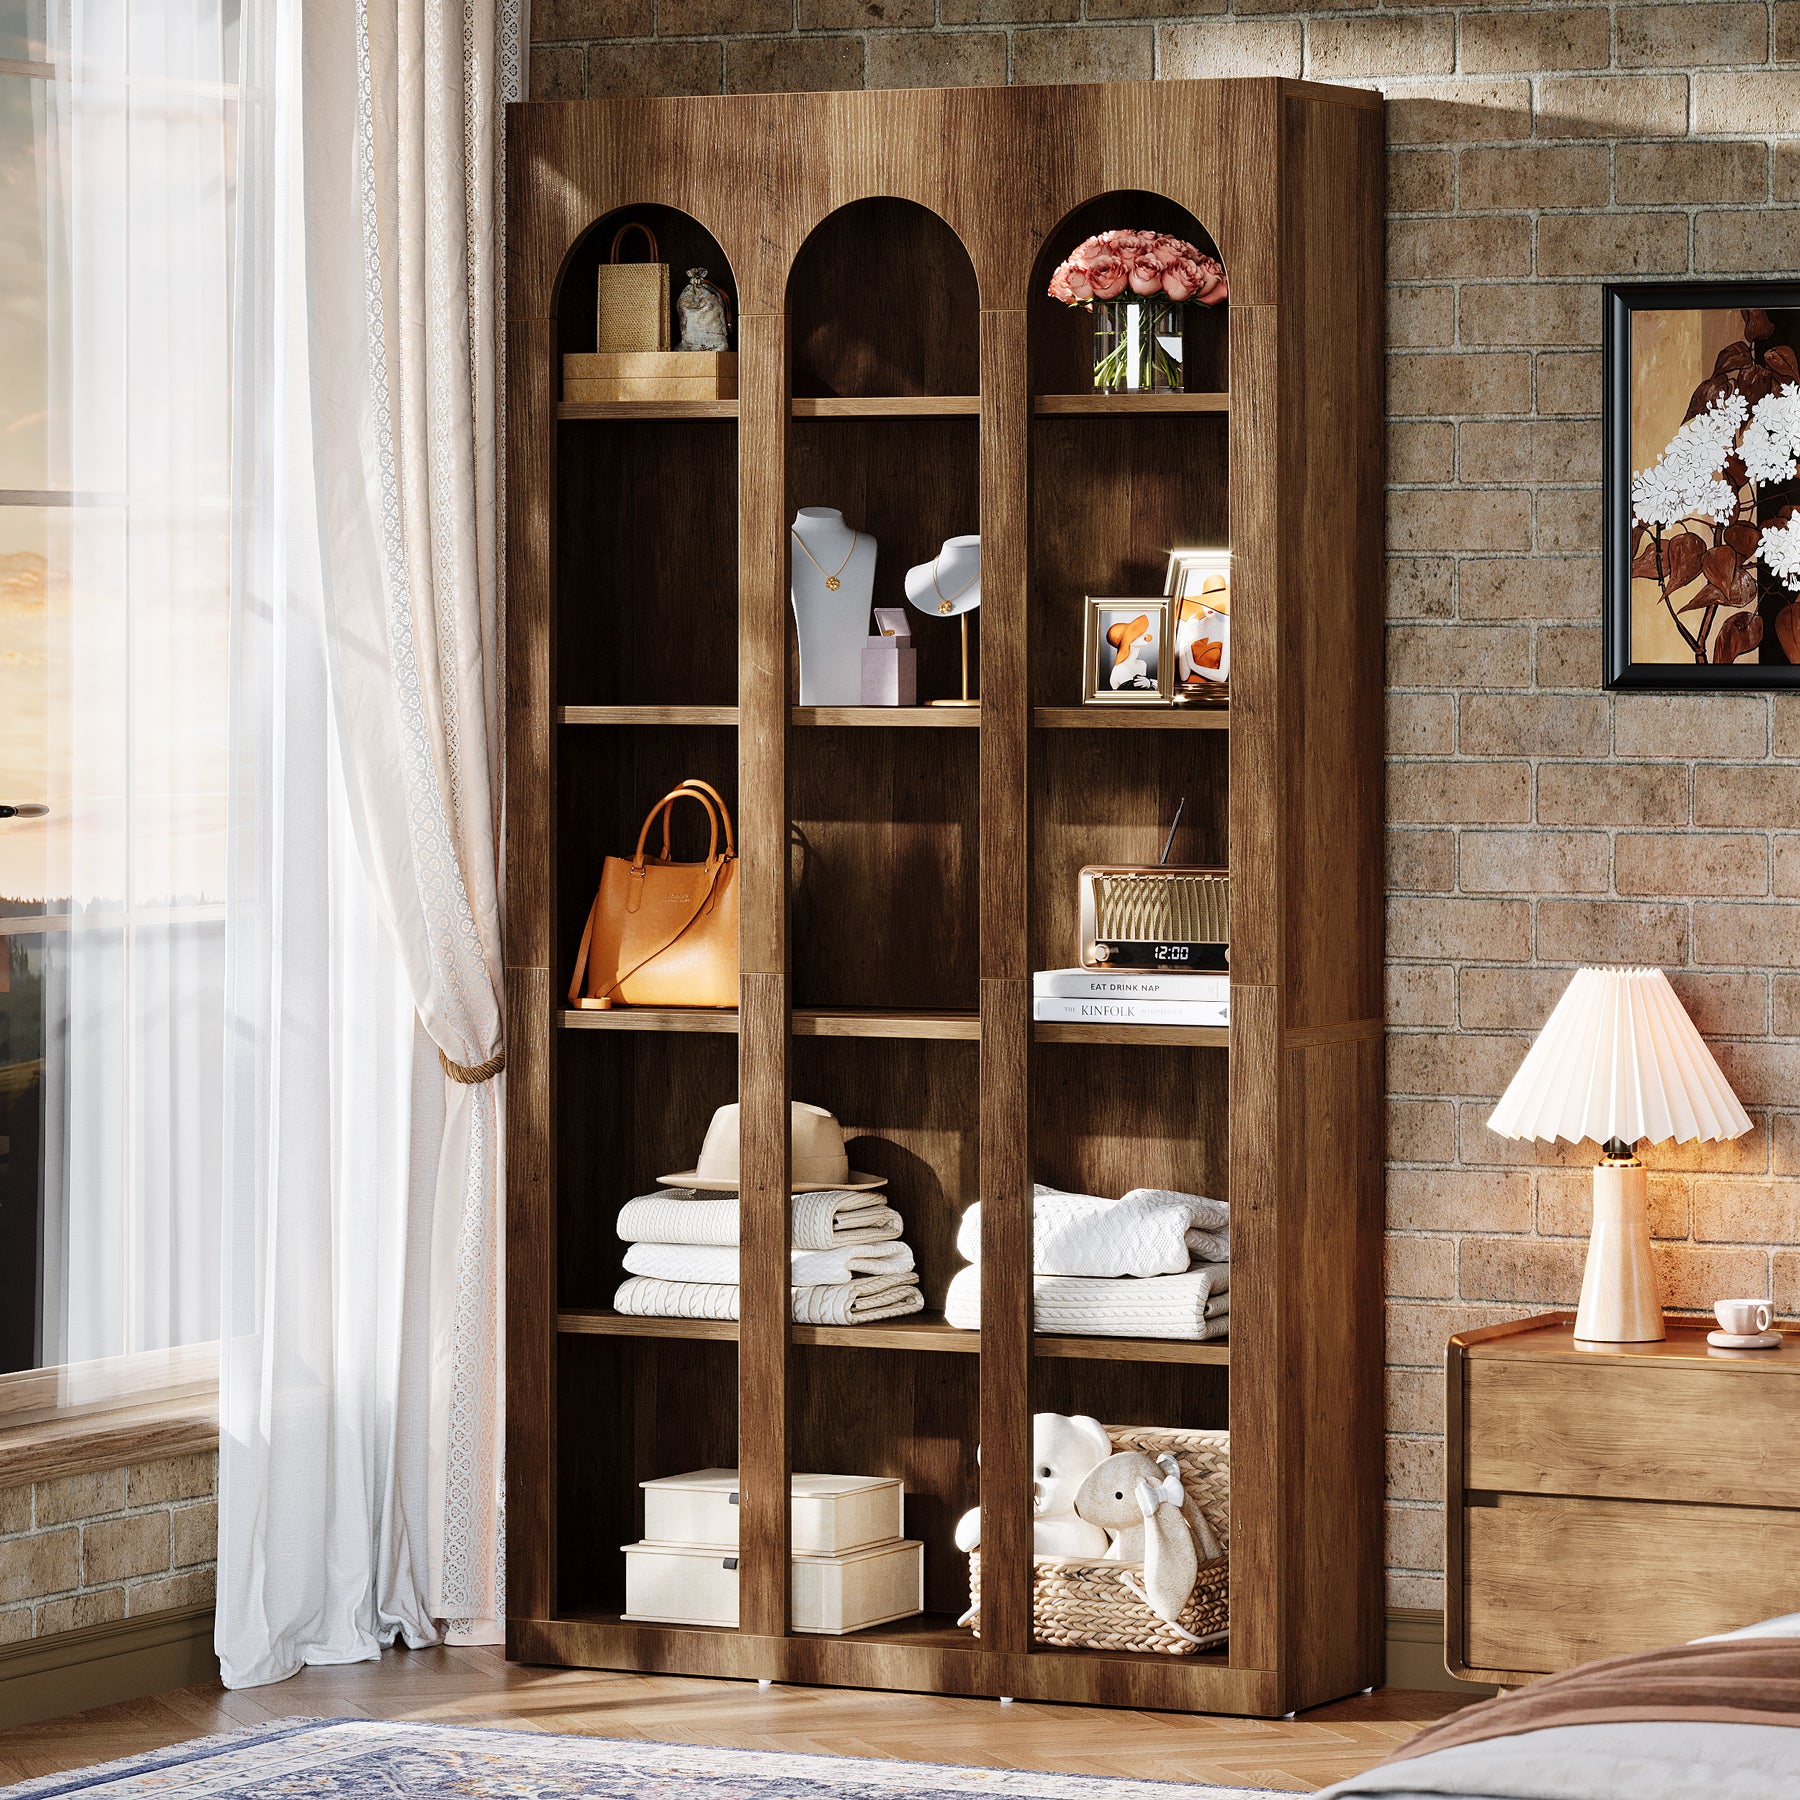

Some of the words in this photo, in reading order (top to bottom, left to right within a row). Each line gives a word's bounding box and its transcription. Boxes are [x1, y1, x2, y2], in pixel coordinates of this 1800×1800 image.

[1154, 945, 1189, 960] 12:00
[1090, 983, 1107, 991] EAT
[1109, 983, 1138, 992] DRINK
[1141, 984, 1160, 992] NAP
[1081, 1005, 1135, 1017] KINFOLK
